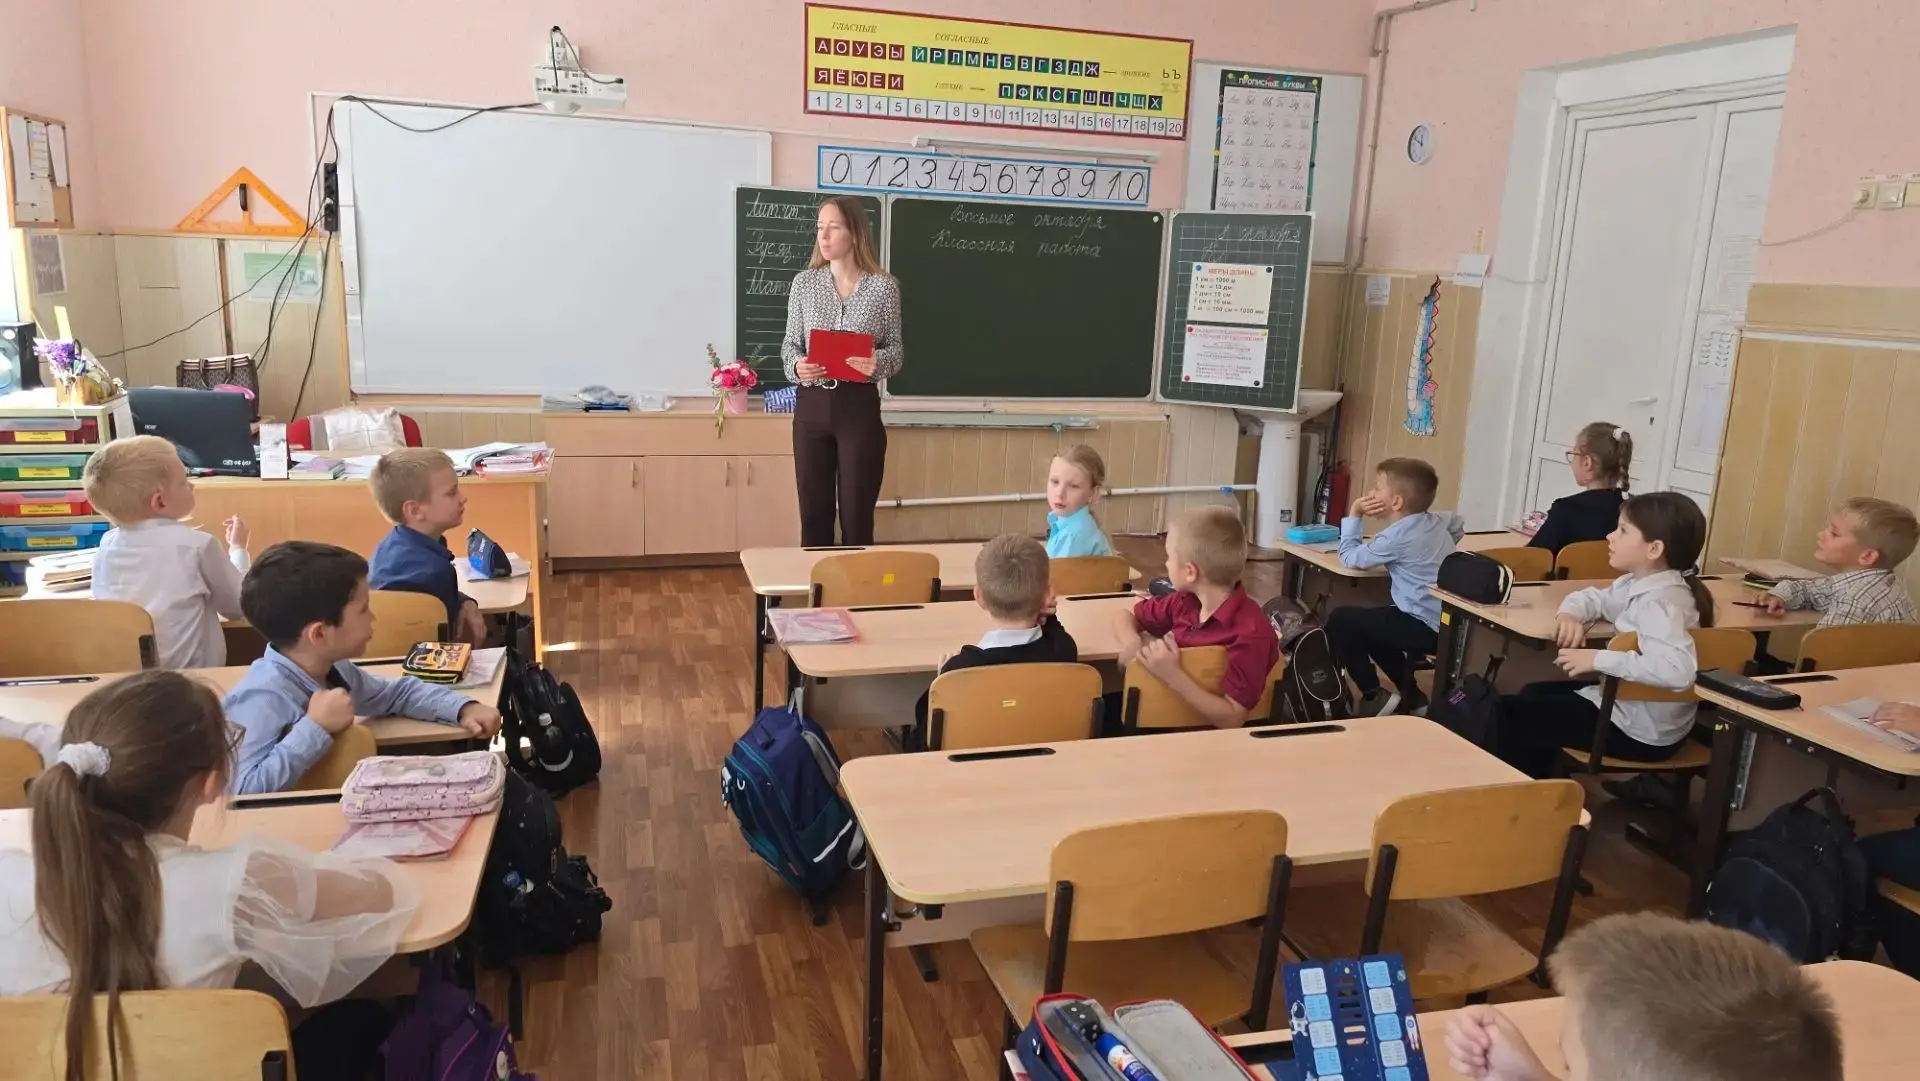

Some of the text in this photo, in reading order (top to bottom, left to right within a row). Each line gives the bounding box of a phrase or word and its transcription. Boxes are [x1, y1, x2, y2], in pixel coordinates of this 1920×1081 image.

[832, 21, 877, 34] ГЛАСНЫЕ
[934, 32, 991, 45] СОГЛАСНЫЕ
[817, 40, 903, 58] А О У Э Ы
[915, 46, 925, 61] Й
[933, 49, 942, 61] Р
[950, 51, 960, 63] Л
[967, 52, 978, 65] М
[986, 54, 995, 66] Н
[1003, 56, 1012, 68] Б
[1021, 57, 1029, 69] В
[1037, 59, 1046, 71] Г
[1055, 60, 1063, 72] З
[1070, 62, 1080, 76] Д
[1086, 63, 1099, 76] Ж
[817, 70, 901, 88] Я Ё Ю Е И
[1002, 85, 1011, 96] П
[1018, 86, 1028, 98] Ф
[1036, 88, 1045, 99] К
[1053, 89, 1062, 101] С
[1070, 90, 1077, 101] Т
[1085, 92, 1097, 104] Ш
[1101, 93, 1112, 106] Ц
[1119, 93, 1127, 104] Ч
[1133, 95, 1145, 108] Щ
[1151, 97, 1159, 108] Х
[816, 96, 1182, 134] 1 2 3 4 5 6 7 8 9 10 11 12 13 14 15 16 17 18 19 20
[830, 153, 1144, 200] 0 1 2 3 4 5 6 7 8 9 10
[950, 204, 1106, 238] Восьмое октября
[931, 229, 1101, 257] Классная работа
